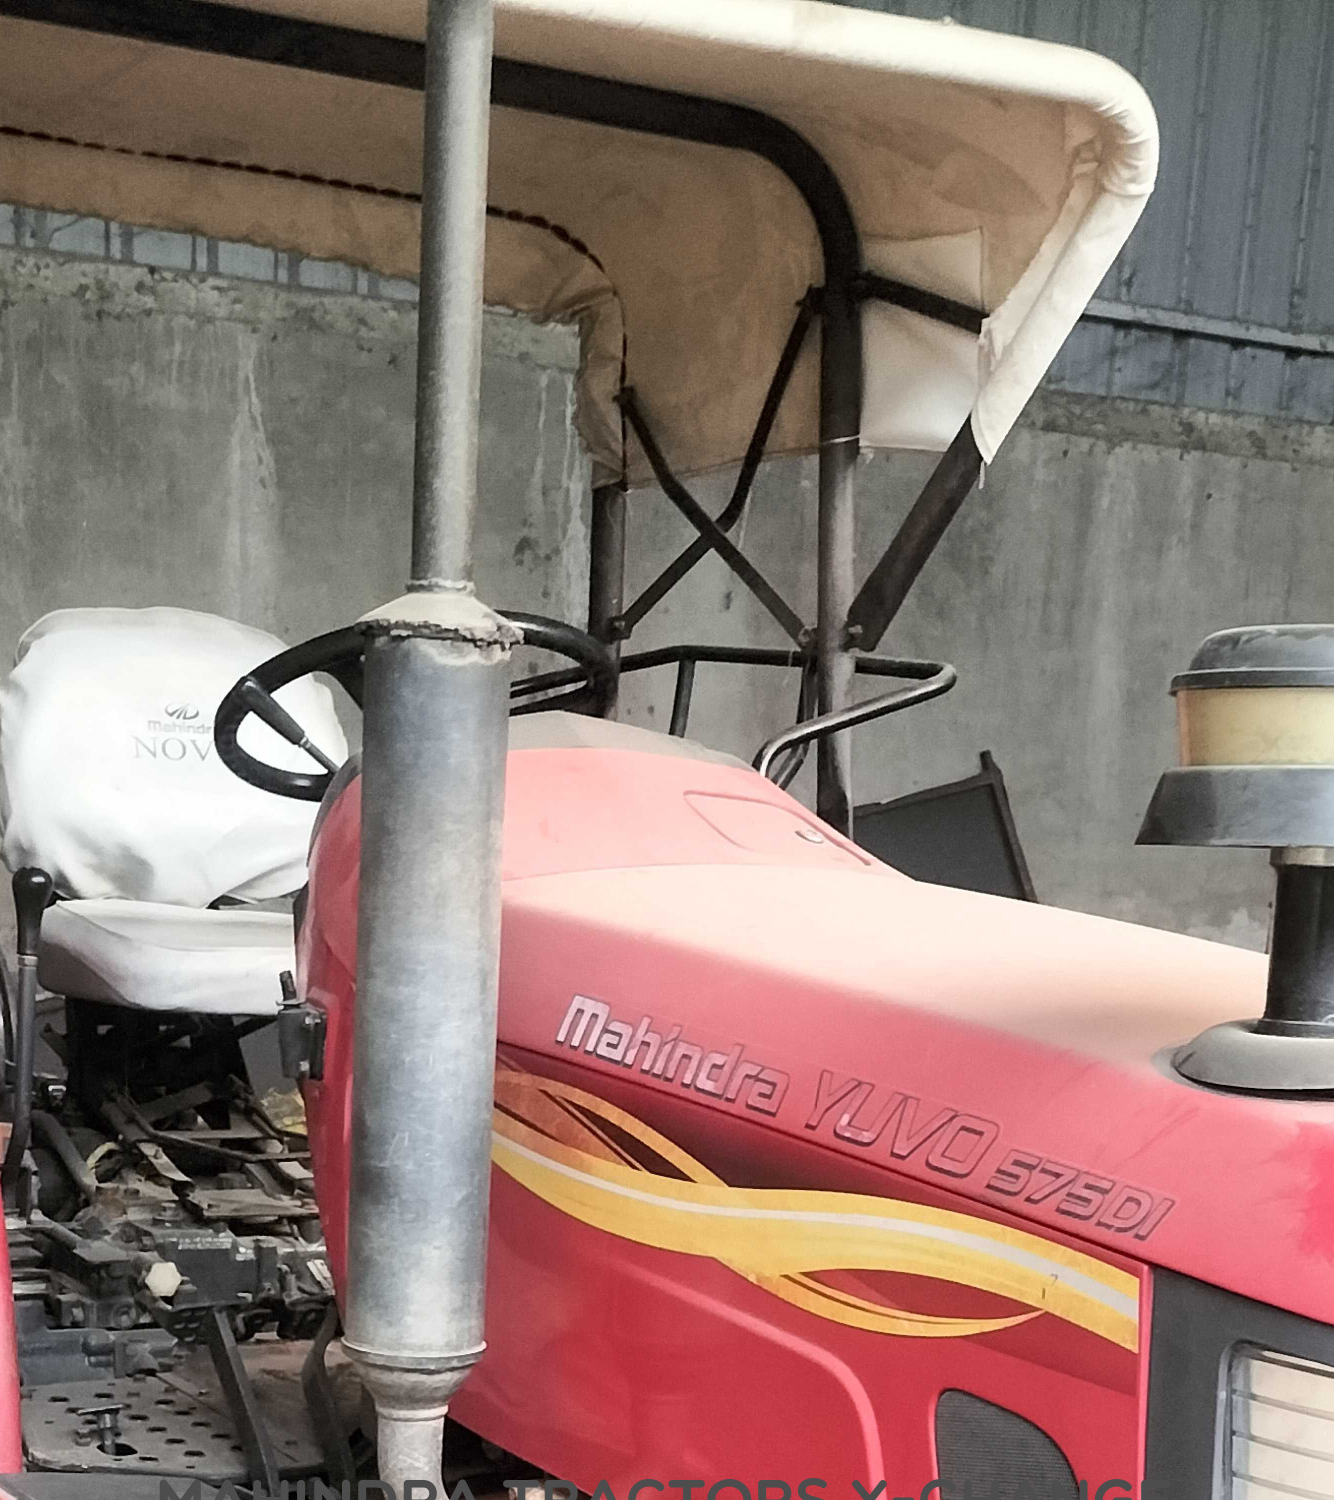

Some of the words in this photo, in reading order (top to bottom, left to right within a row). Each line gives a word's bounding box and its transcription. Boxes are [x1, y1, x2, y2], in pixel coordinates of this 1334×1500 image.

[147, 720, 213, 735] Mahindr
[131, 735, 214, 762] NOV
[555, 994, 791, 1117] Mahindra
[804, 1069, 1001, 1180] YUVO
[985, 1148, 1177, 1242] 575DI
